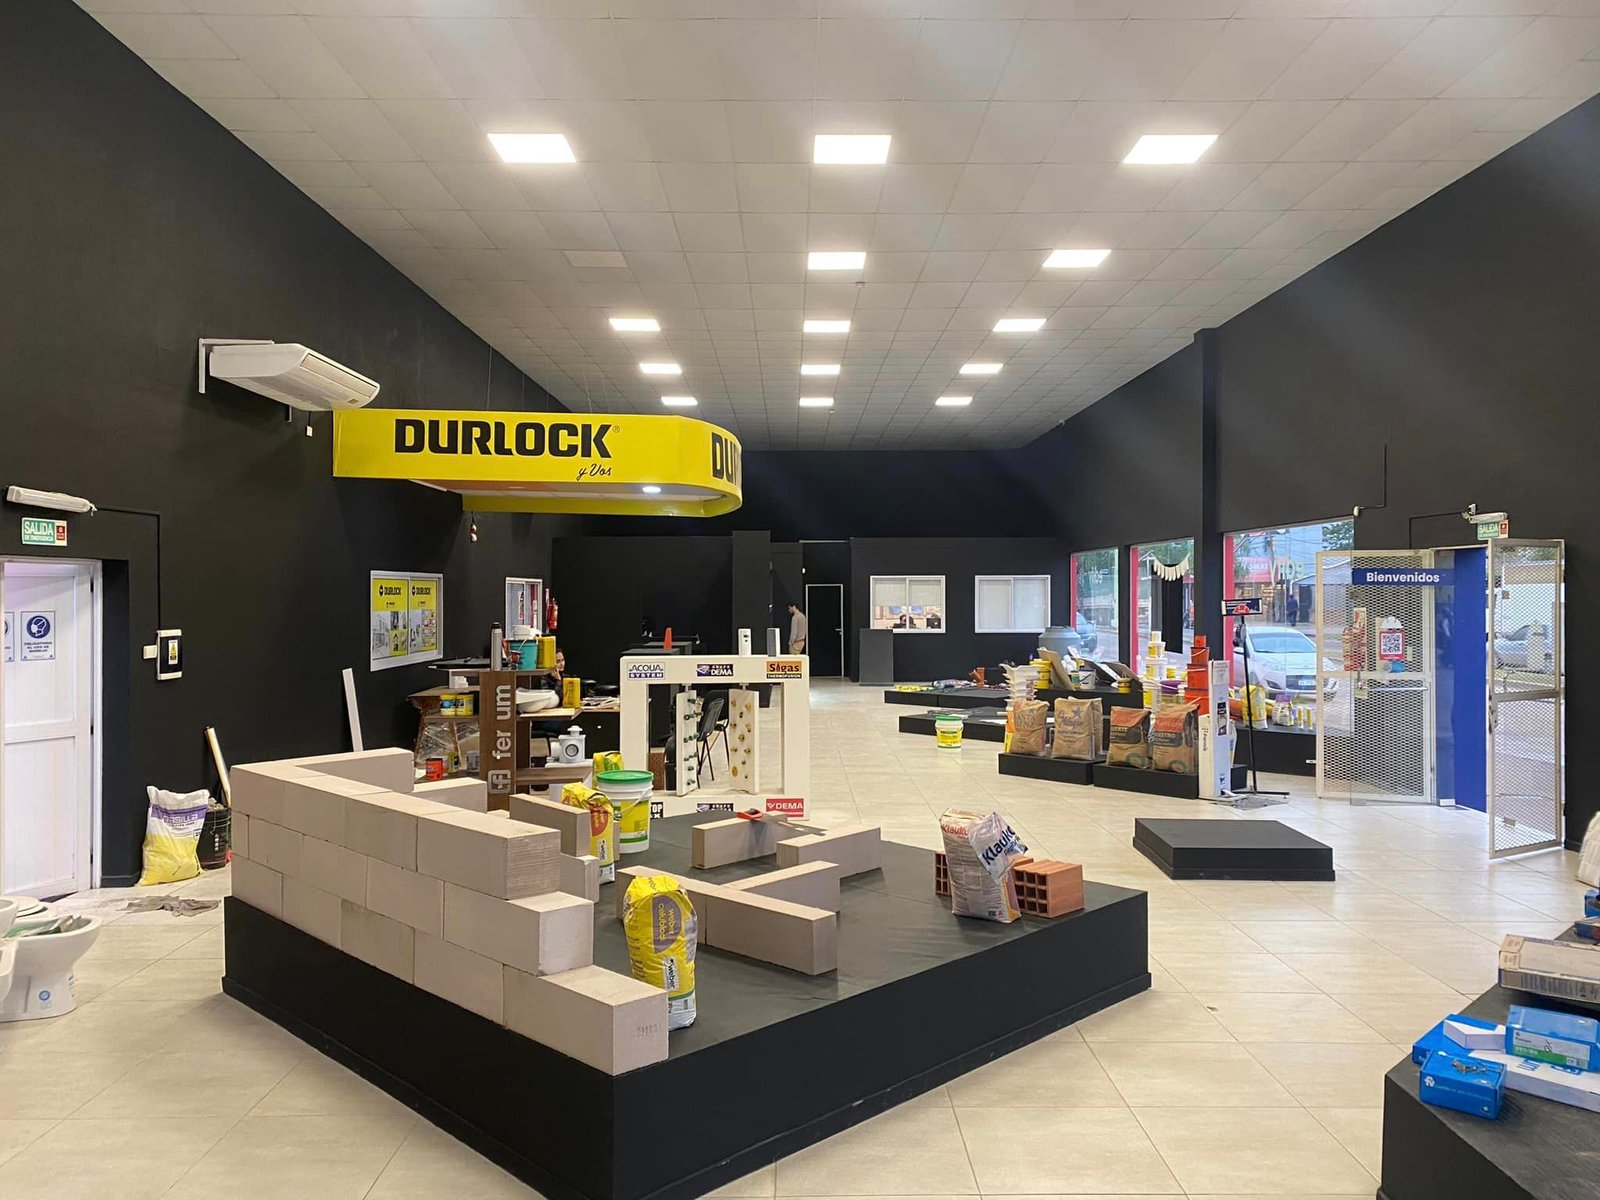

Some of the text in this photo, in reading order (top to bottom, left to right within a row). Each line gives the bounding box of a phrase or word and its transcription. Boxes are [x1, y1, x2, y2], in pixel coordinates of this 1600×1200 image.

[394, 418, 612, 458] DURLOCK
[576, 463, 612, 481] y Vos
[24, 521, 54, 536] SALIDA
[1366, 571, 1440, 583] Bienvenidos
[629, 664, 663, 672] ACQUA
[711, 668, 733, 676] DEMA
[775, 802, 804, 810] DEMA
[667, 965, 676, 989] weber
